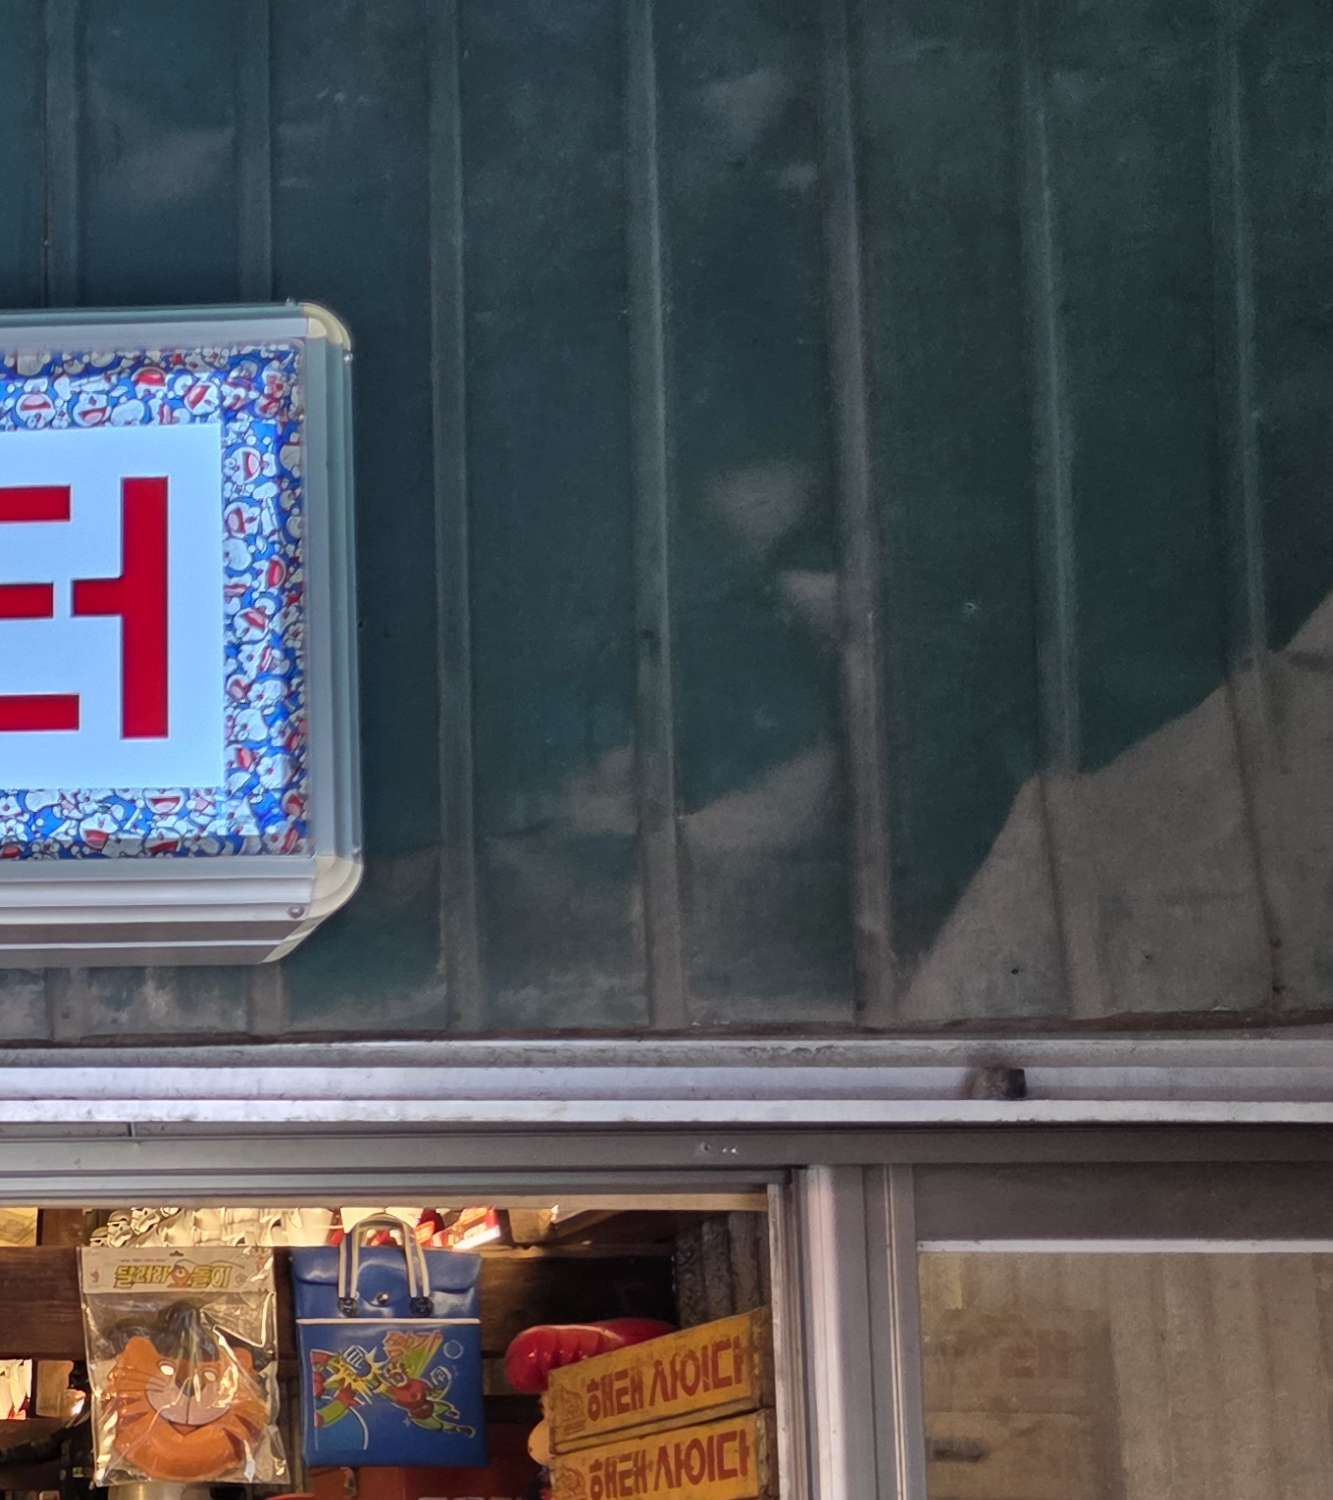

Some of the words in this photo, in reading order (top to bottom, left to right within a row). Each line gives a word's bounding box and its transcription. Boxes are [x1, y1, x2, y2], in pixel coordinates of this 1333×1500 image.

[586, 1367, 645, 1422] 해태
[648, 1336, 744, 1406] 사이다
[653, 1428, 750, 1492] 사이다
